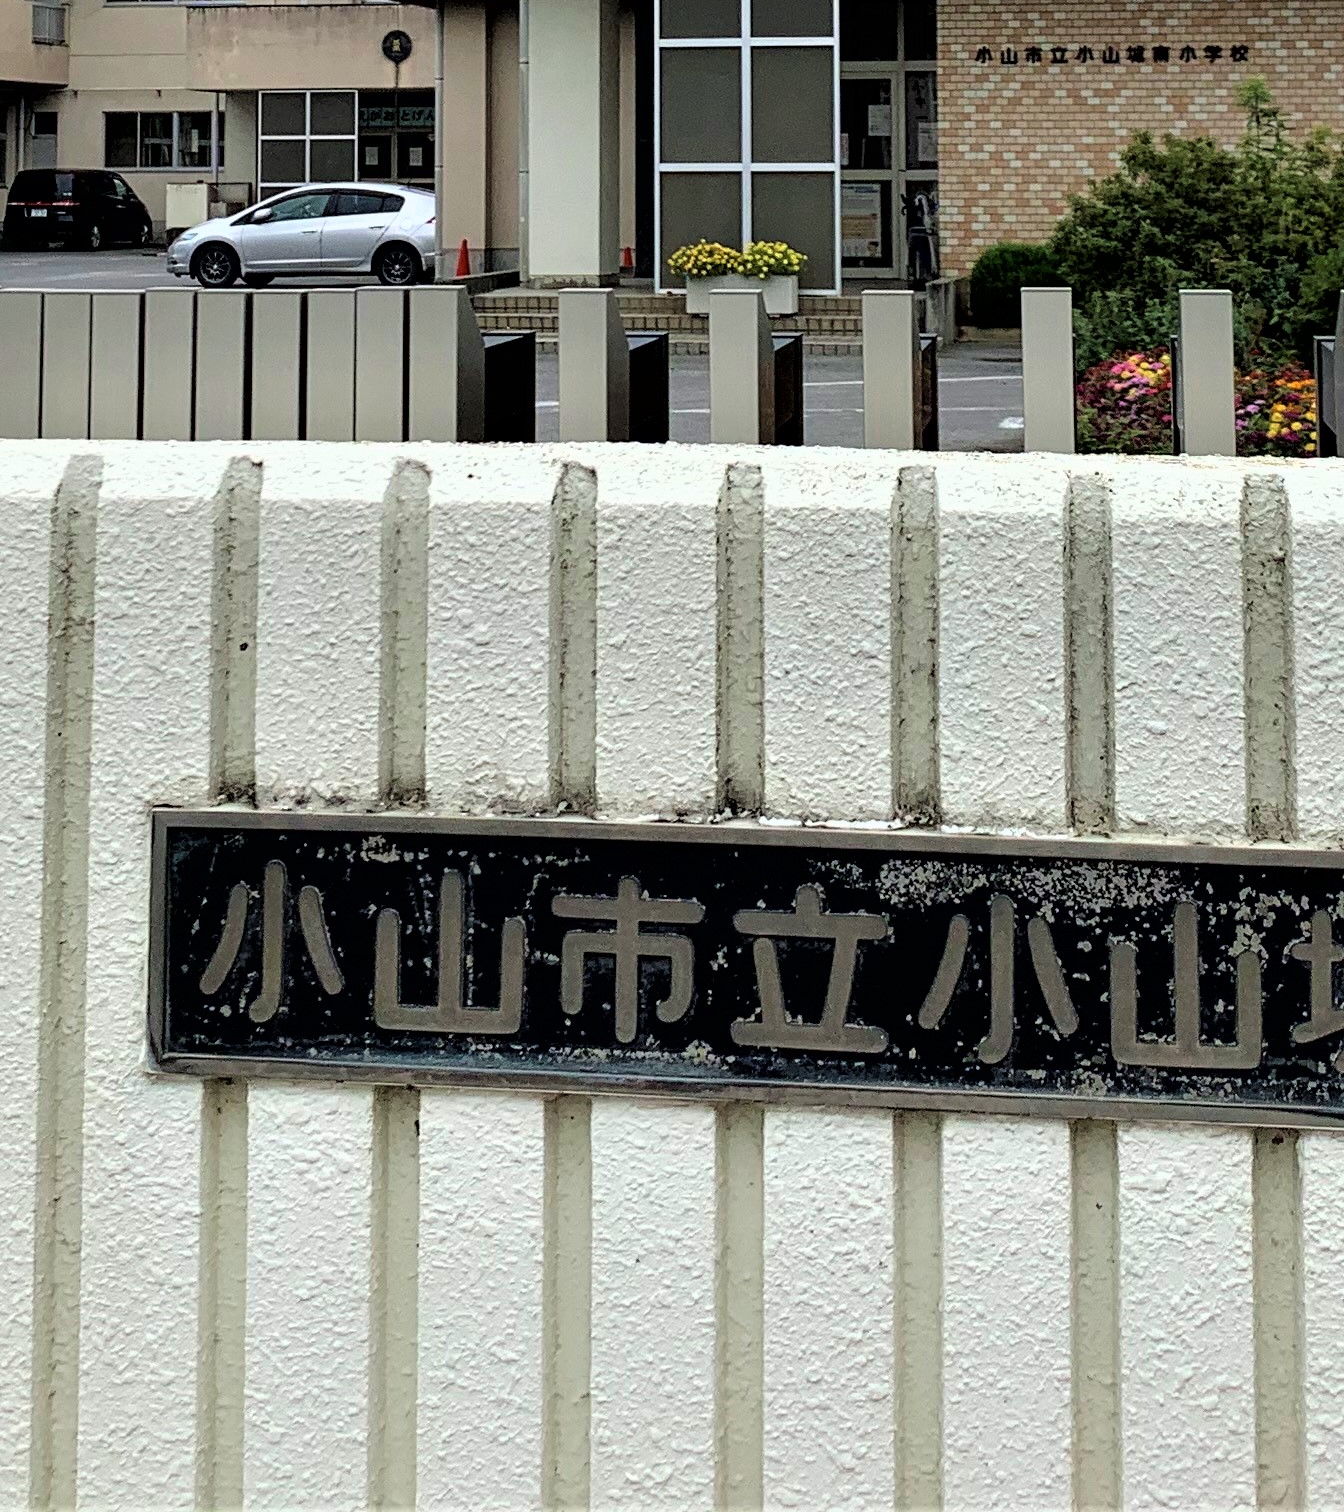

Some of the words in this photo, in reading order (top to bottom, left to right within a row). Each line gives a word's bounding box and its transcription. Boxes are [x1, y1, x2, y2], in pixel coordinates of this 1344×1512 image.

[974, 45, 1250, 65] 小山市立小山城南小学校
